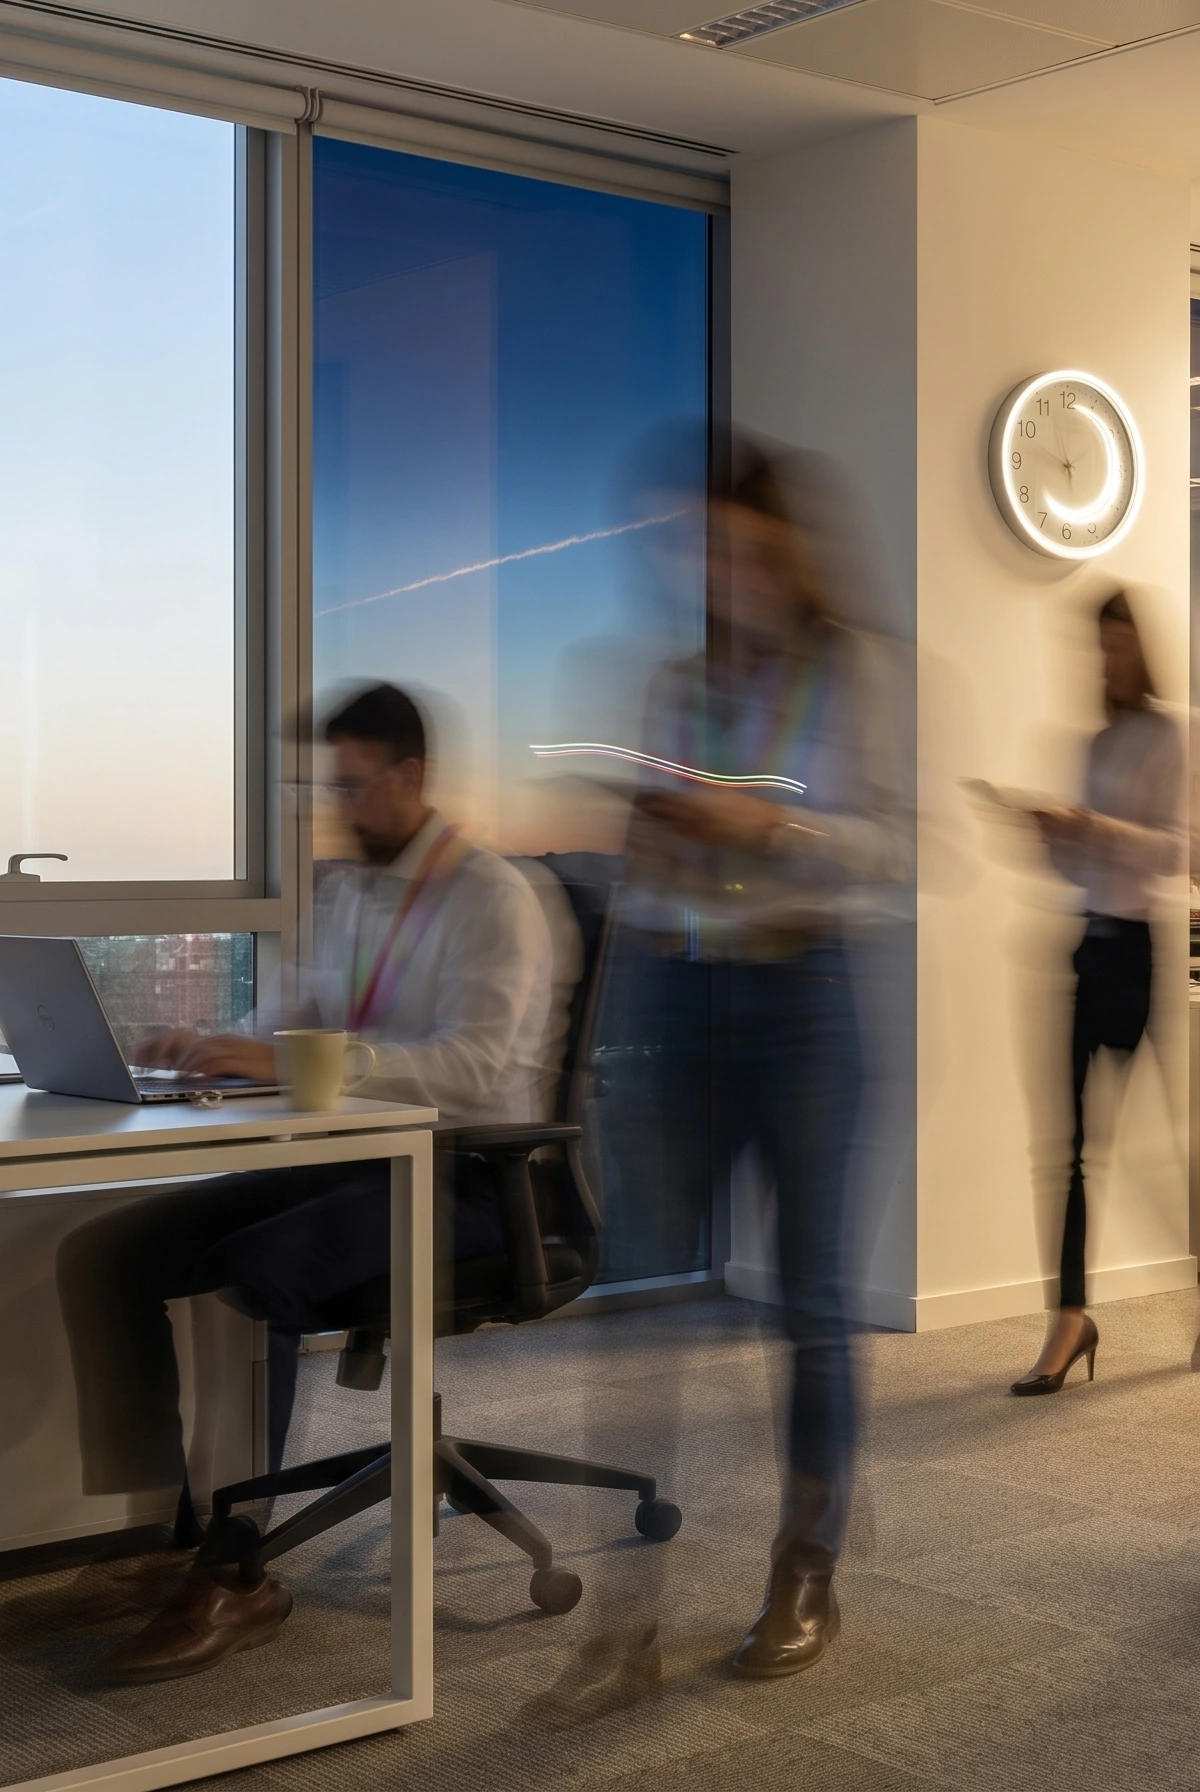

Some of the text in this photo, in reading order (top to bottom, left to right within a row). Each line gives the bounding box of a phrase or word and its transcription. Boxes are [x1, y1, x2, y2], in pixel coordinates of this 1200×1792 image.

[1036, 398, 1050, 416] 11
[1059, 391, 1076, 410] 12
[1017, 420, 1036, 439] 10
[1011, 451, 1022, 470] 9
[1019, 485, 1030, 503] 8
[1037, 511, 1048, 529] 7
[1061, 522, 1072, 540] 6
